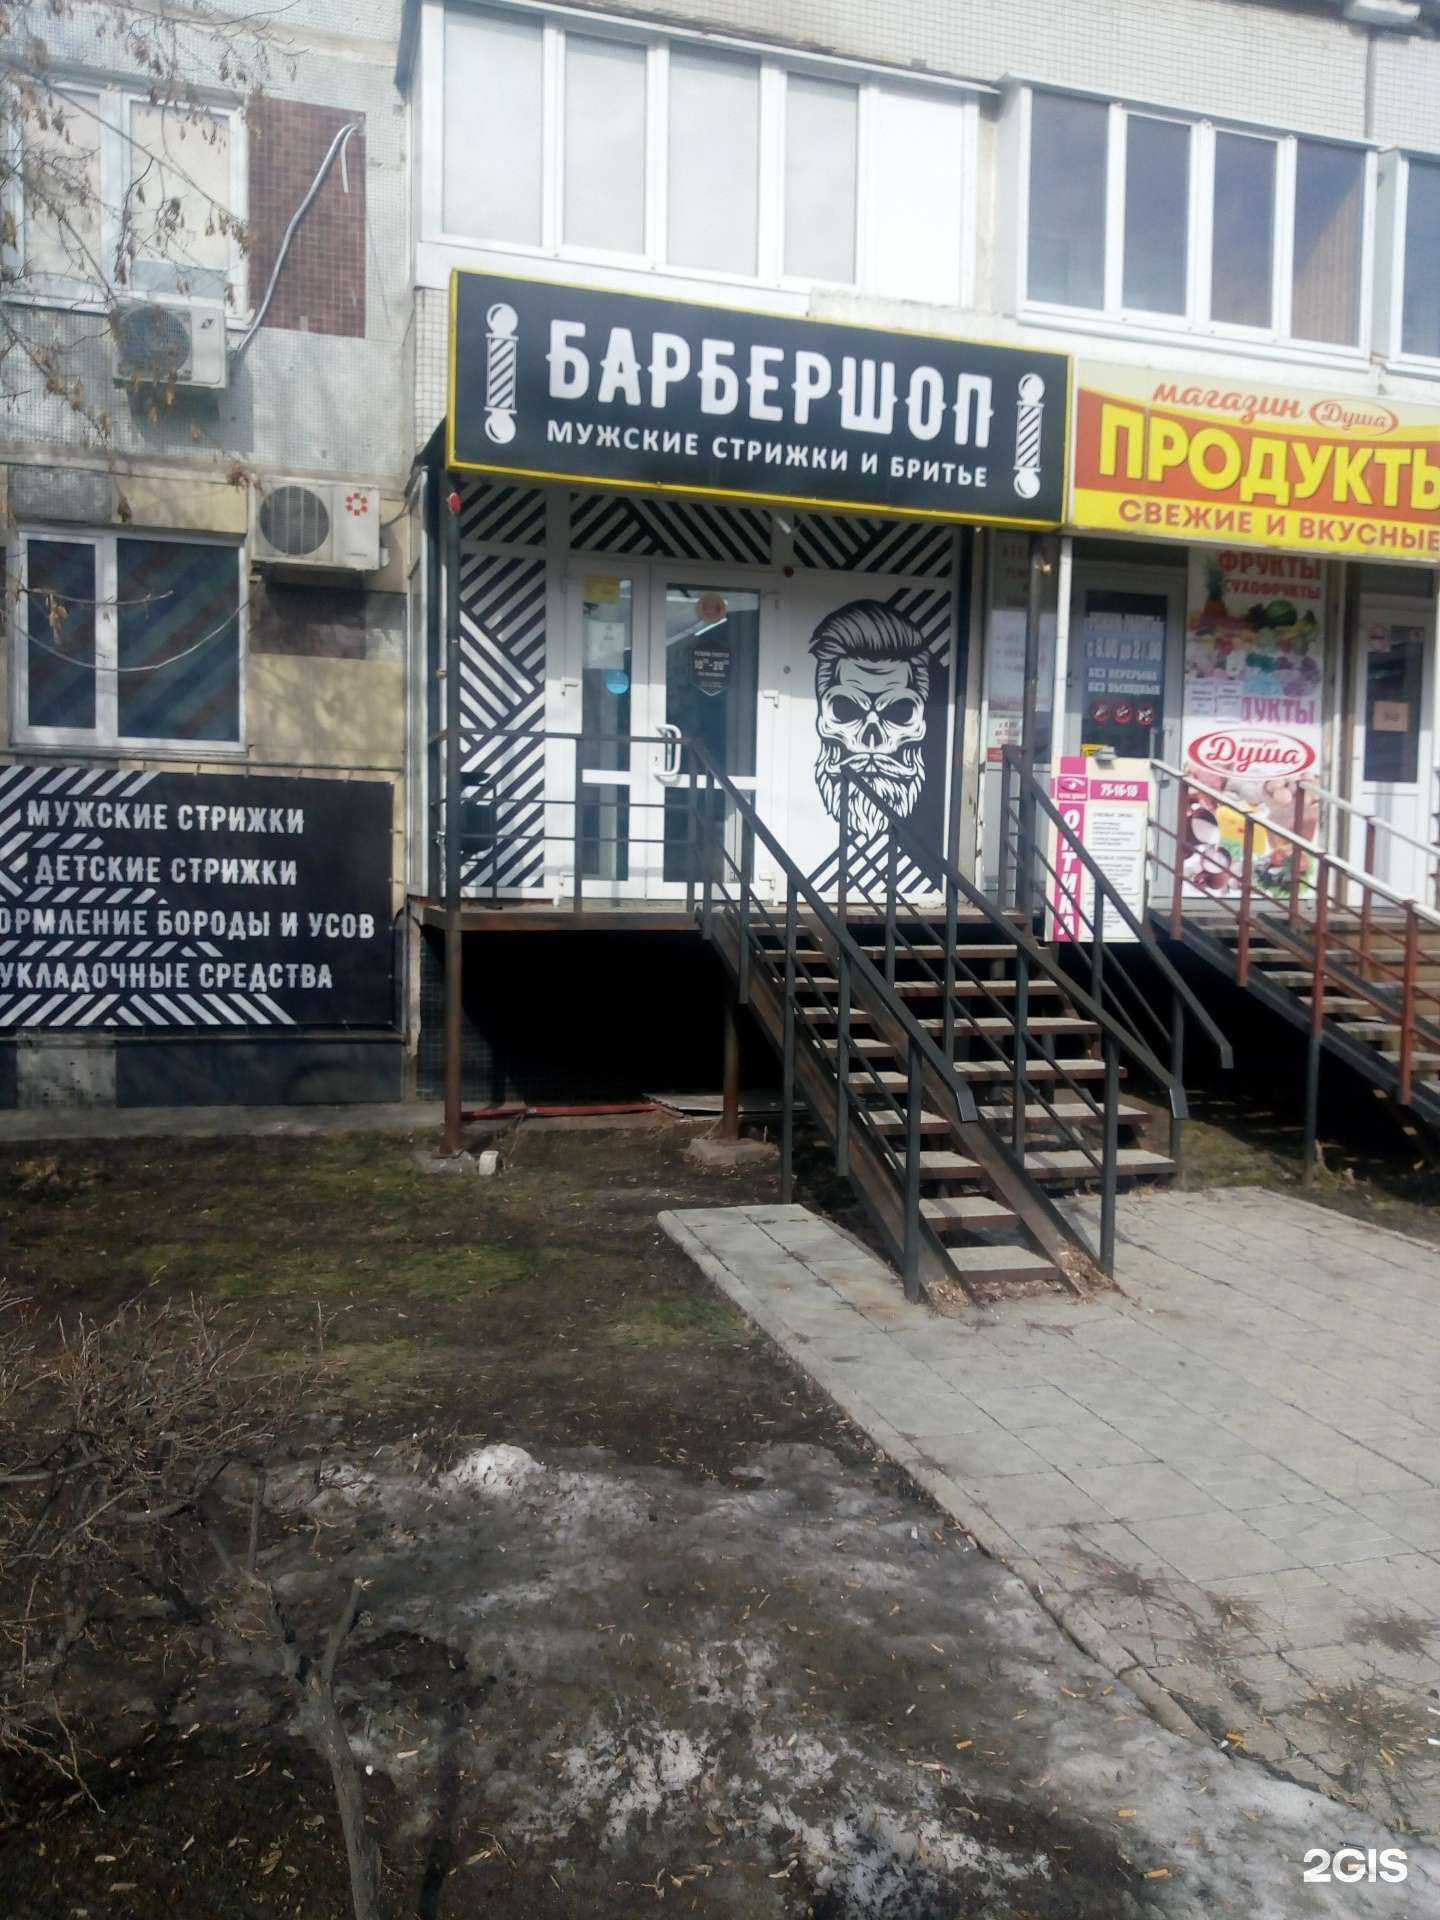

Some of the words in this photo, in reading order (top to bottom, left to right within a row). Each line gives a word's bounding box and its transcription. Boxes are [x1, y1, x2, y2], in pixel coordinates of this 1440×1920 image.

[546, 319, 995, 448] БАРБЕРШОП
[1152, 384, 1302, 424] магазин
[1321, 403, 1389, 431] Душа
[547, 419, 699, 456] МУЖСКИЕ
[712, 436, 850, 471] СТРИЖКИ
[861, 452, 879, 475] И
[890, 454, 989, 488] БРИТЬЕ
[1118, 499, 1253, 534] СВЕЖИЕ
[1266, 514, 1286, 537] И
[1300, 518, 1440, 553] ВКУСНЫЕ
[1217, 550, 1322, 580] ФРУКТЫ
[1206, 736, 1300, 773] Душа
[26, 800, 168, 831] МУЖСКИЕ
[177, 804, 305, 834] СТРИЖКИ
[34, 854, 161, 885] ДЕТСКИЕ
[171, 857, 298, 886] СТРИЖКИ
[158, 910, 270, 941] БОРОДЫ
[282, 912, 298, 937] И
[309, 912, 375, 939] УСОВ
[0, 962, 190, 993] УКЛАДОЧНЫЕ
[199, 962, 333, 993] СРЕДСТВА
